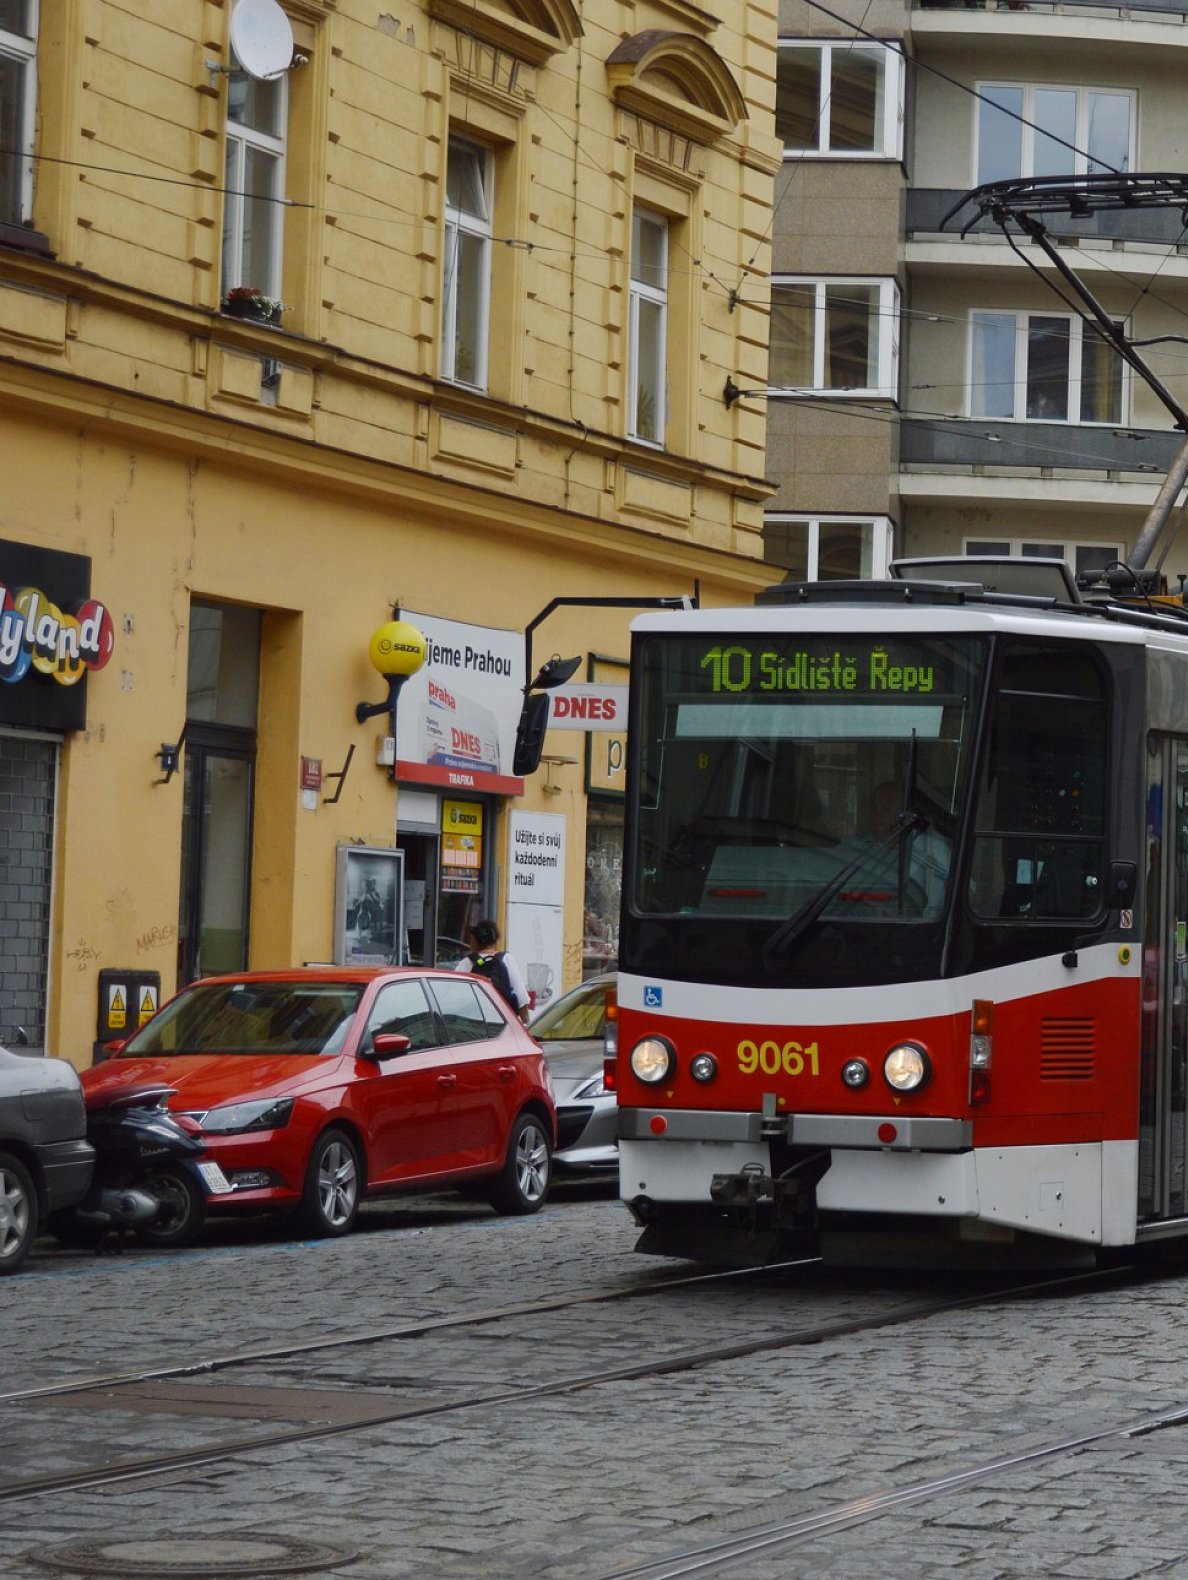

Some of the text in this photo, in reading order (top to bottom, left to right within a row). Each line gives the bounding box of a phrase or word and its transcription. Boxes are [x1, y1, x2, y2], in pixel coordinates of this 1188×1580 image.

[422, 635, 511, 677] ijeme Prahou
[700, 645, 934, 692] 10 Sídliště Řepy
[428, 681, 457, 711] praha
[553, 696, 617, 720] DNES
[450, 727, 482, 755] DNES
[449, 773, 474, 786] TRAFIKA
[515, 829, 537, 847] Užijte
[538, 832, 545, 845] si
[514, 872, 535, 887] rituál
[737, 1040, 820, 1075] 9061
